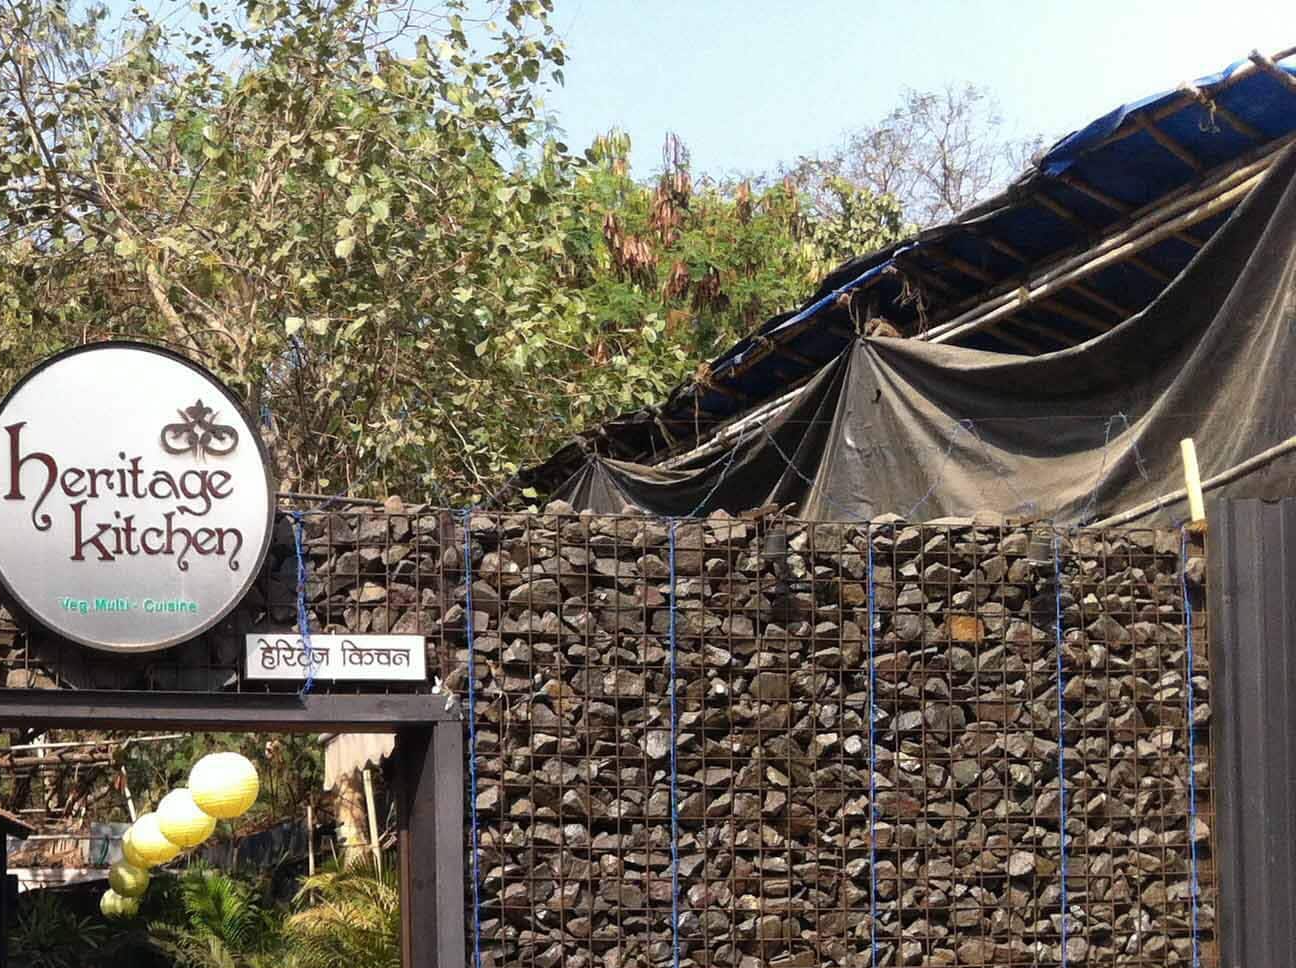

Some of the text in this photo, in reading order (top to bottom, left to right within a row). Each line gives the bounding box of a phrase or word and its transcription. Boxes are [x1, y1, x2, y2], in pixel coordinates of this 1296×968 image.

[4, 421, 234, 532] heritage
[70, 499, 244, 571] kitchen
[60, 598, 88, 615] Veg
[95, 598, 129, 612] Multi
[144, 598, 198, 613] Cuisine
[341, 639, 411, 667] किचन
